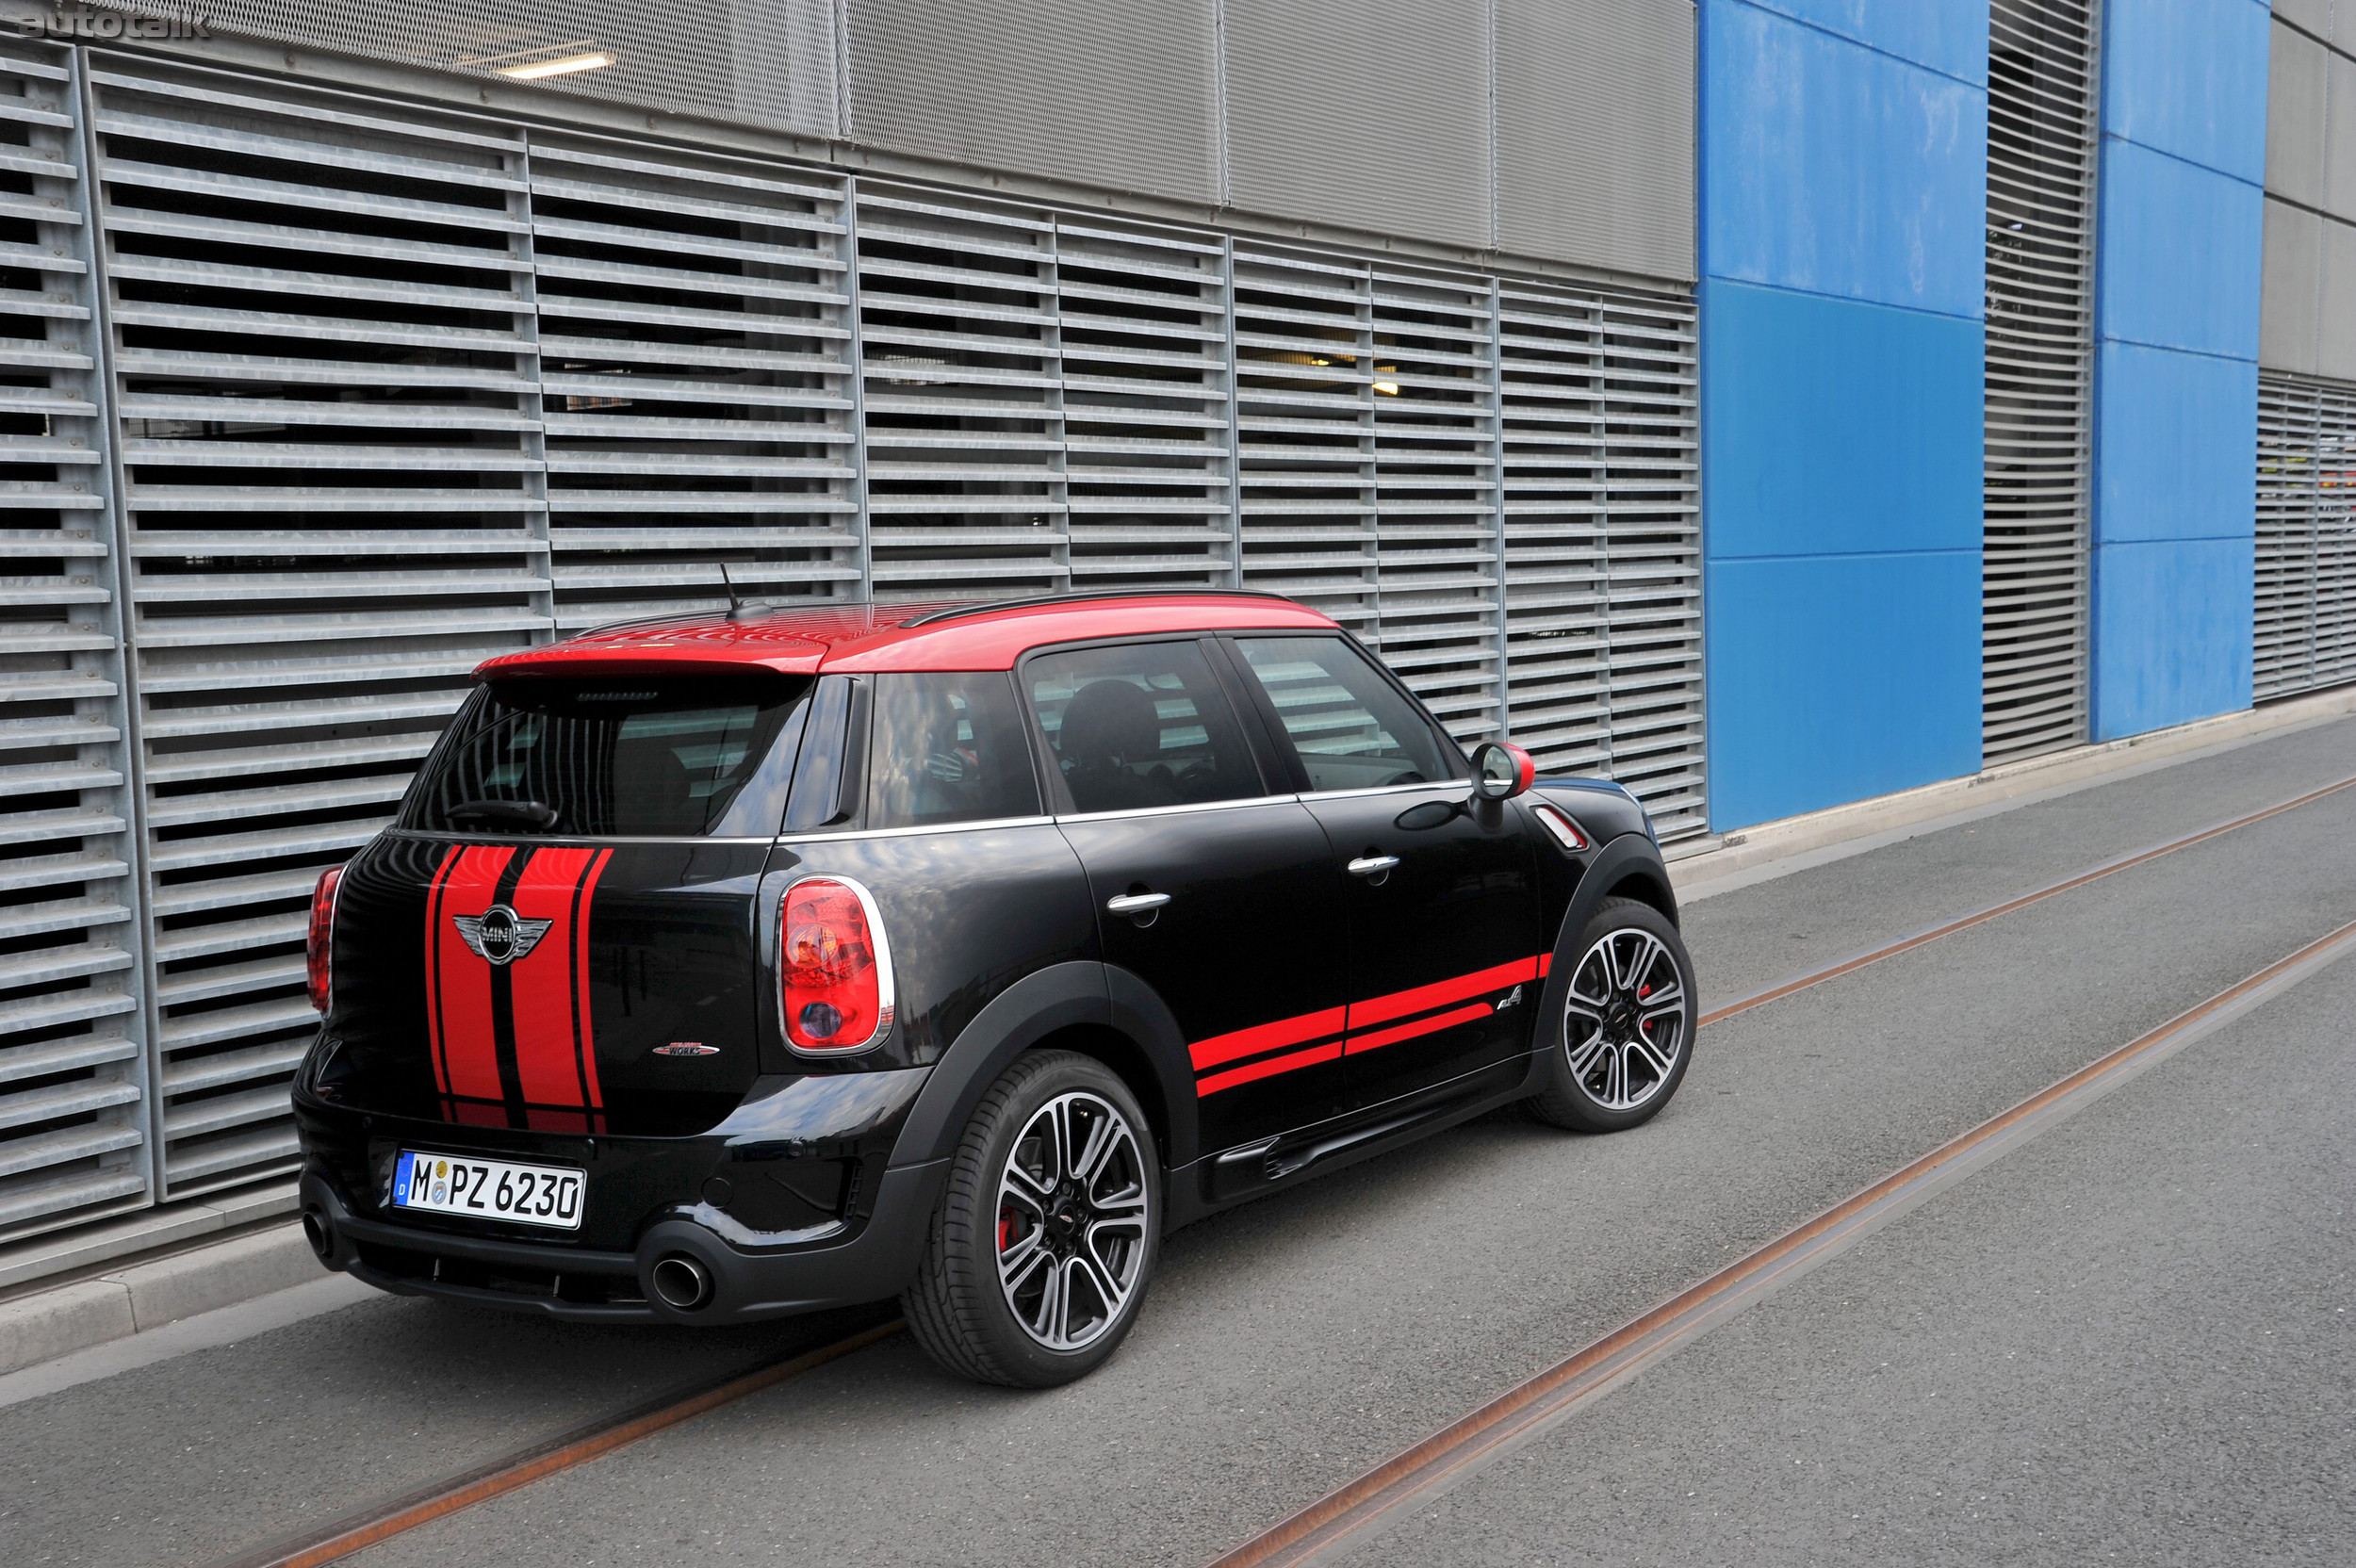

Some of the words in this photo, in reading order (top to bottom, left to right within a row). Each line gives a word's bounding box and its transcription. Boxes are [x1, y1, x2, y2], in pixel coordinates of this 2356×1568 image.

[483, 926, 513, 942] MINI
[399, 1184, 405, 1195] D
[411, 1160, 433, 1201] M
[450, 1165, 488, 1208] PZ
[496, 1170, 578, 1218] 6230
